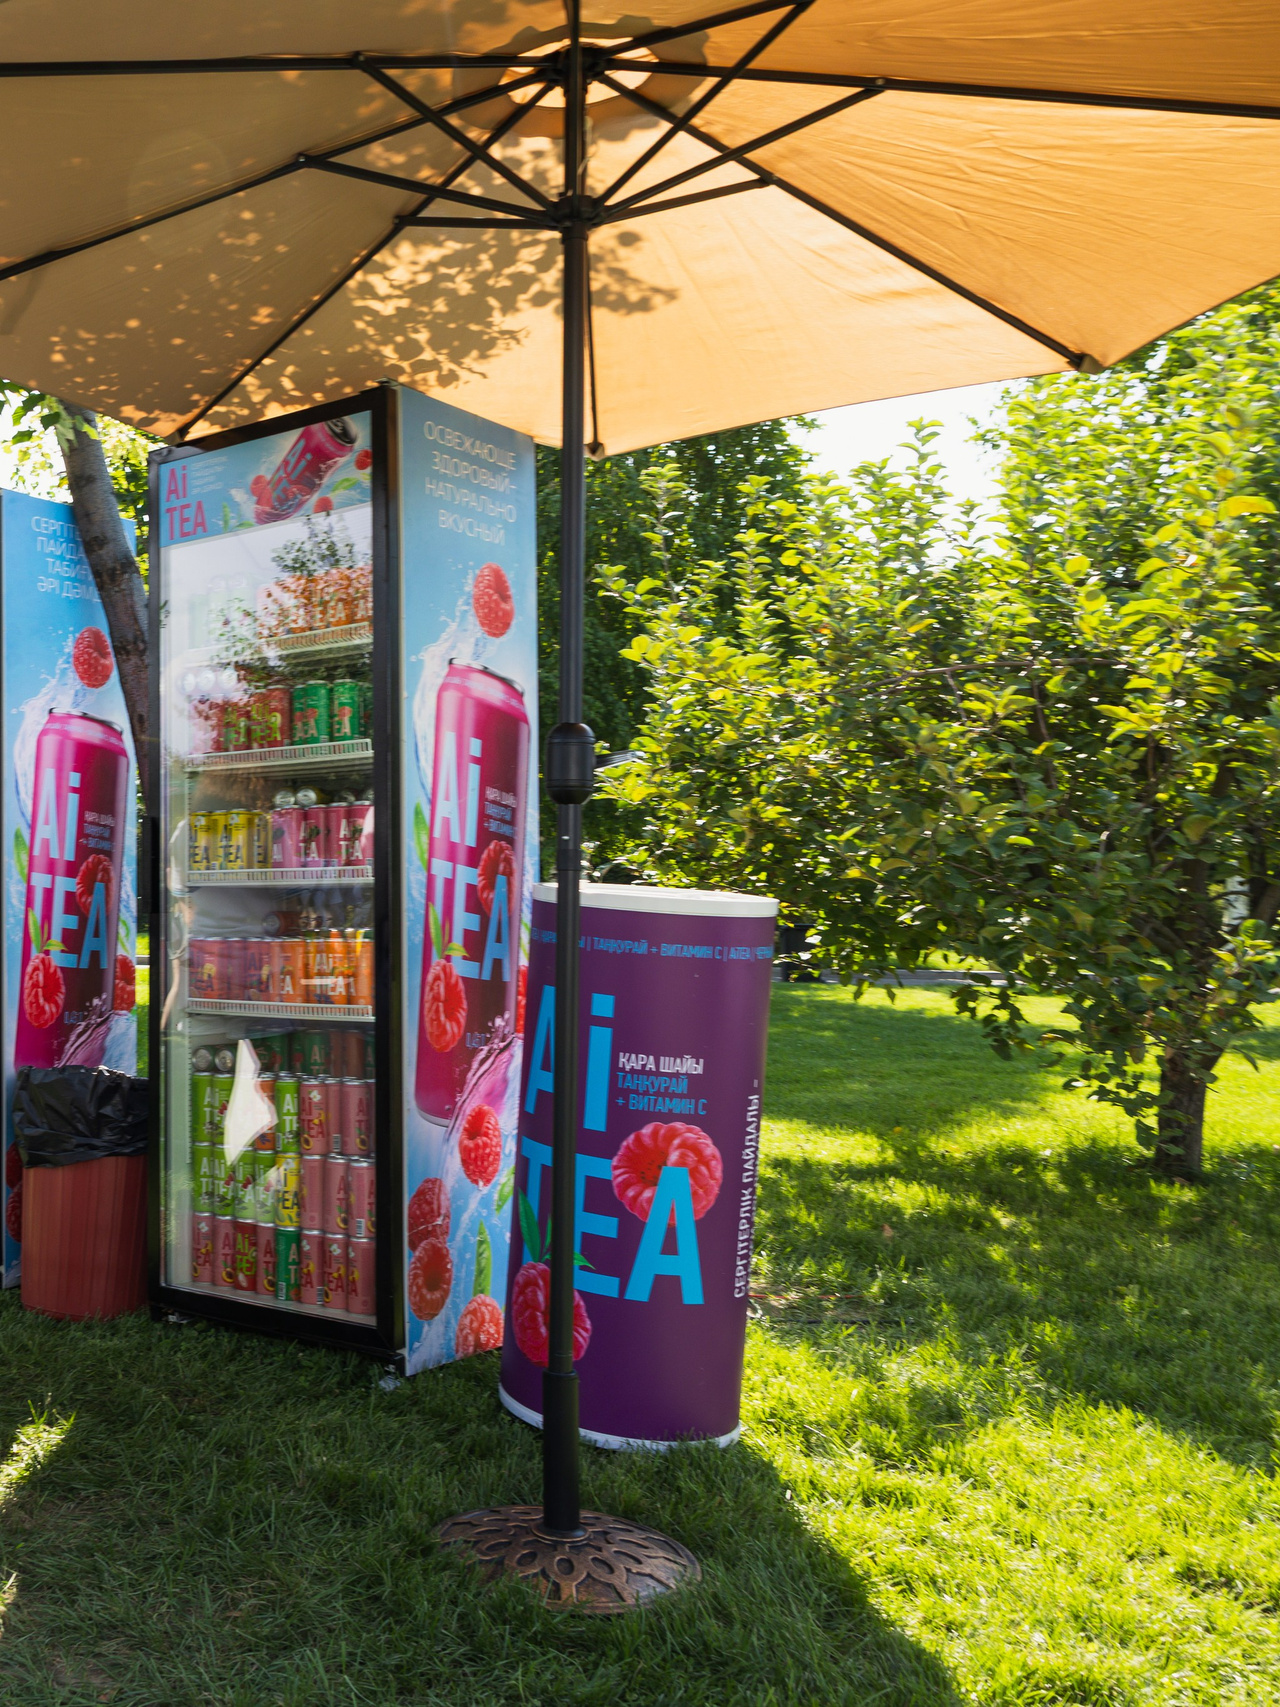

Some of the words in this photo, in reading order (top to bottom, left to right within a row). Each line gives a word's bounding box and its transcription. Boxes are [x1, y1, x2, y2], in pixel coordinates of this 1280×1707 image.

[424, 421, 517, 471] ОСВЕЖАЮЩЕ
[165, 465, 187, 502] Ai
[424, 477, 517, 523] НАТУРАЛЬНО
[165, 500, 208, 540] TEA
[438, 509, 506, 546] ВКУСНЫЙ
[433, 731, 482, 847] Ai
[32, 767, 81, 861] Ai
[29, 871, 109, 969] TEA
[430, 857, 511, 982] TEA
[661, 943, 713, 959] ВИТАМИН
[616, 1071, 688, 1094] ТАҢҚУРАЙ
[618, 1052, 656, 1071] ҚАРА
[659, 1054, 704, 1075] ШАЙЫ
[628, 1093, 696, 1115] ВИТАМИН
[742, 1094, 760, 1183] ПАЙДАЛЫ
[521, 1135, 705, 1305] TEA
